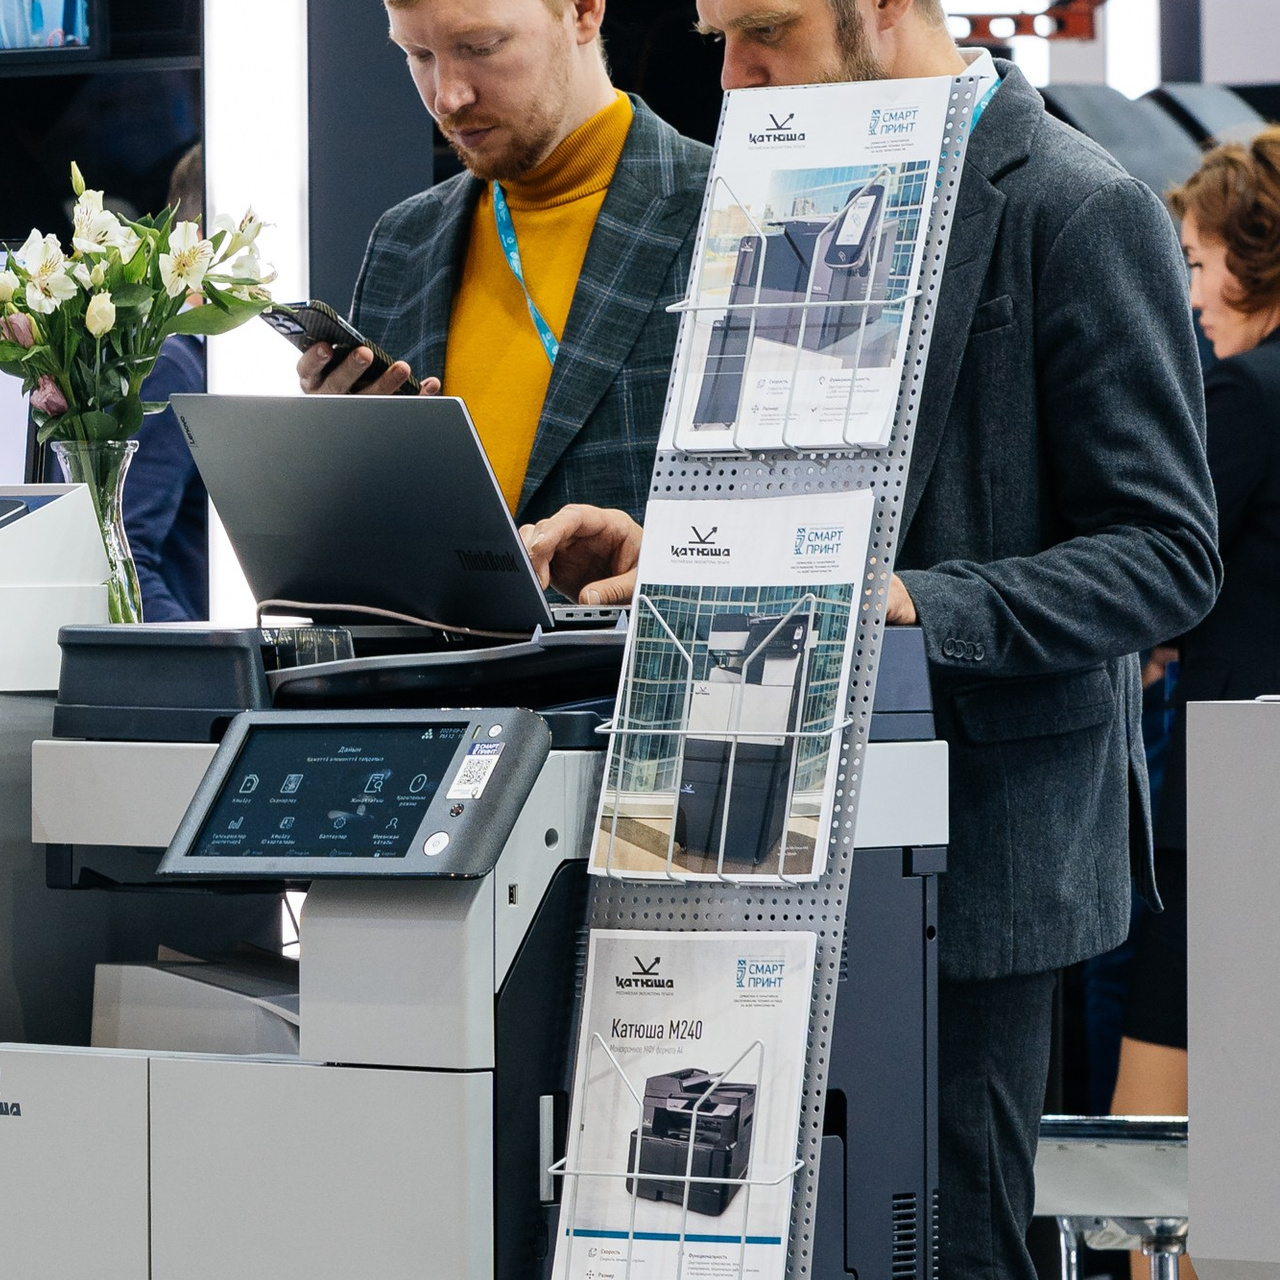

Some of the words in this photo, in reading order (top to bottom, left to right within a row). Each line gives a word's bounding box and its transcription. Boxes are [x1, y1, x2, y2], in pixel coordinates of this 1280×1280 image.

[882, 109, 919, 121] СМАРТ
[880, 122, 917, 134] ПРИНТ
[180, 416, 195, 445] Lenovo
[807, 531, 844, 542] СМАРТ
[805, 543, 842, 555] ПРИНТ
[453, 549, 520, 572] ThinkBook
[749, 963, 785, 975] СМАРТ
[748, 977, 784, 988] ПРИНТ
[611, 1018, 665, 1040] Катюша
[669, 1020, 703, 1040] M240
